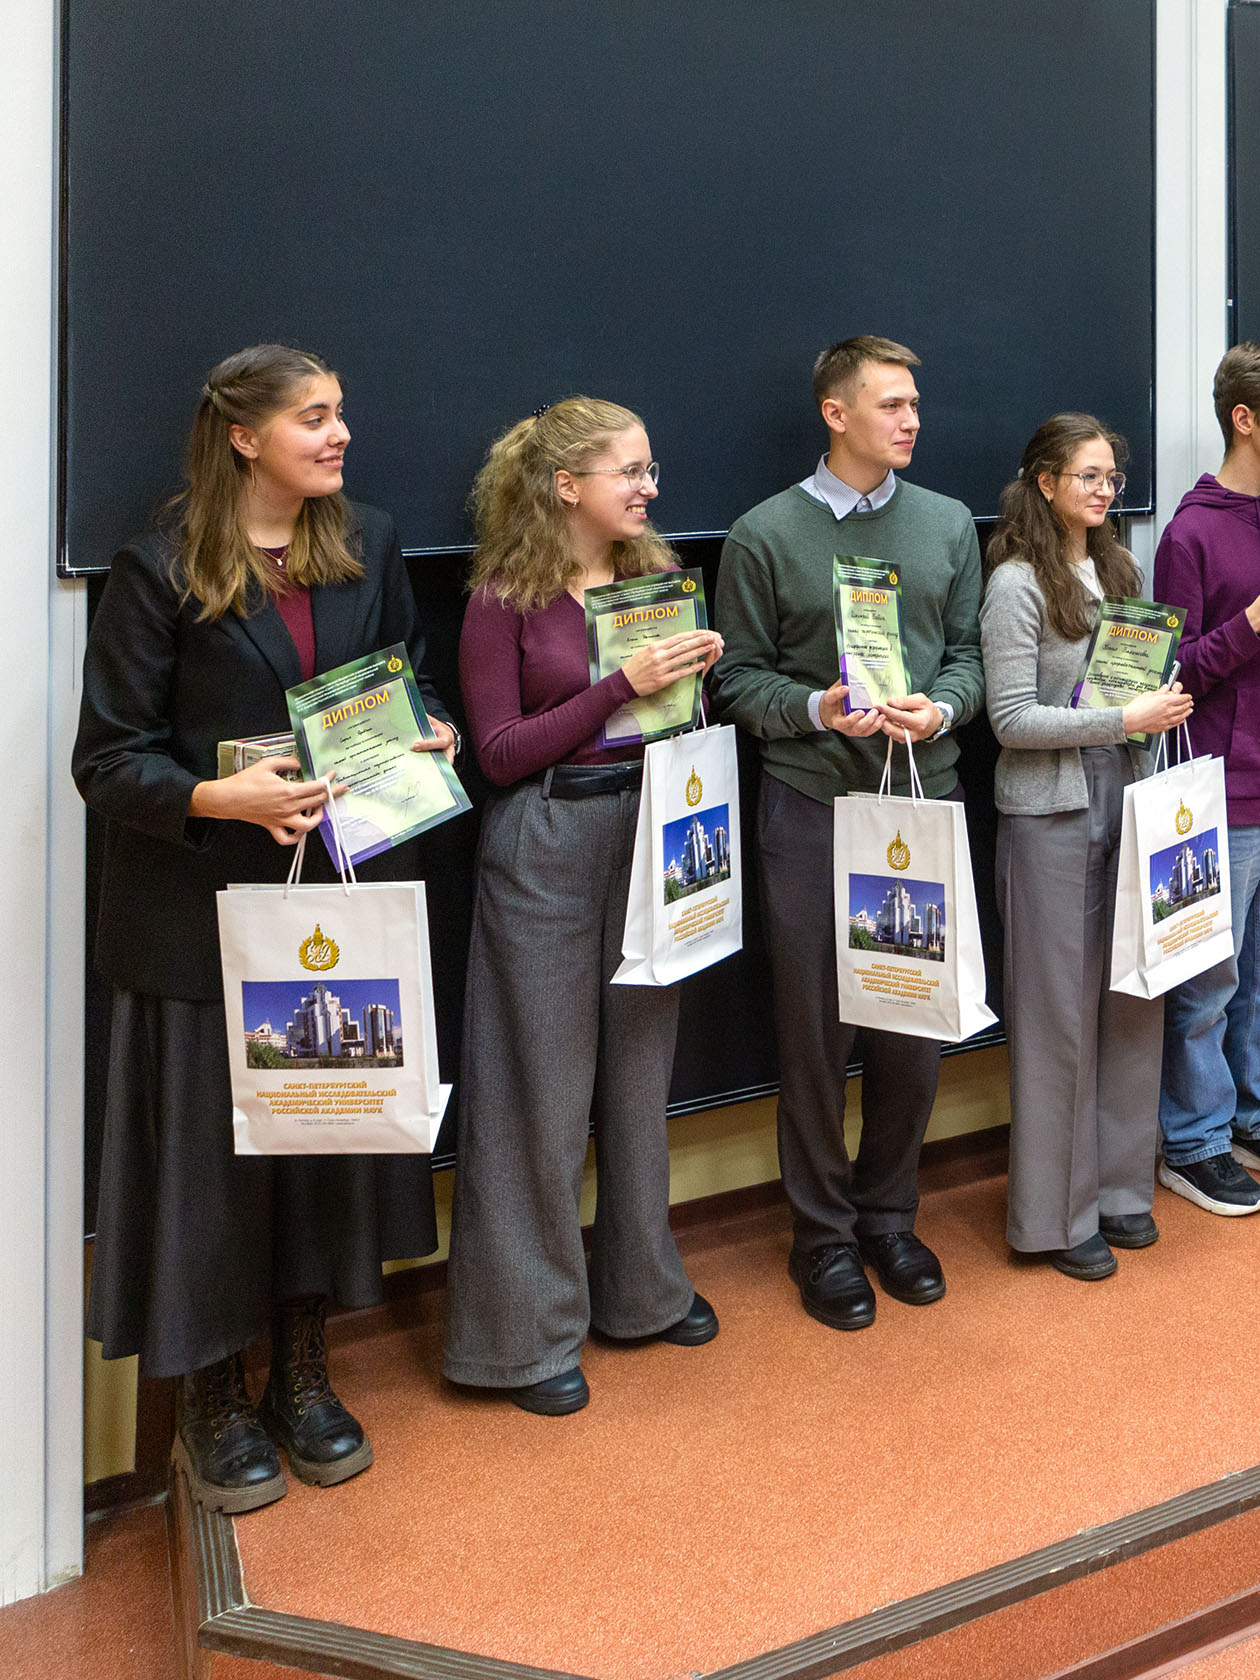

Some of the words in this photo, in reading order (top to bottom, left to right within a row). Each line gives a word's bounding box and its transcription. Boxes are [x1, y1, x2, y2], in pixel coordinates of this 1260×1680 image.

[850, 590, 889, 605] ДИПЛОМ
[612, 605, 679, 629] ДИПЛОМ
[1109, 625, 1159, 643] ДИПЛОМ
[321, 689, 390, 730] ДИПЛОМ
[283, 1080, 367, 1089] САНКТ-ПЕТЕРБУРГСКИЙ
[269, 1098, 332, 1107] АКАДЕМИЧЕСКИЙ
[321, 1107, 362, 1115] АКАДЕМИИ
